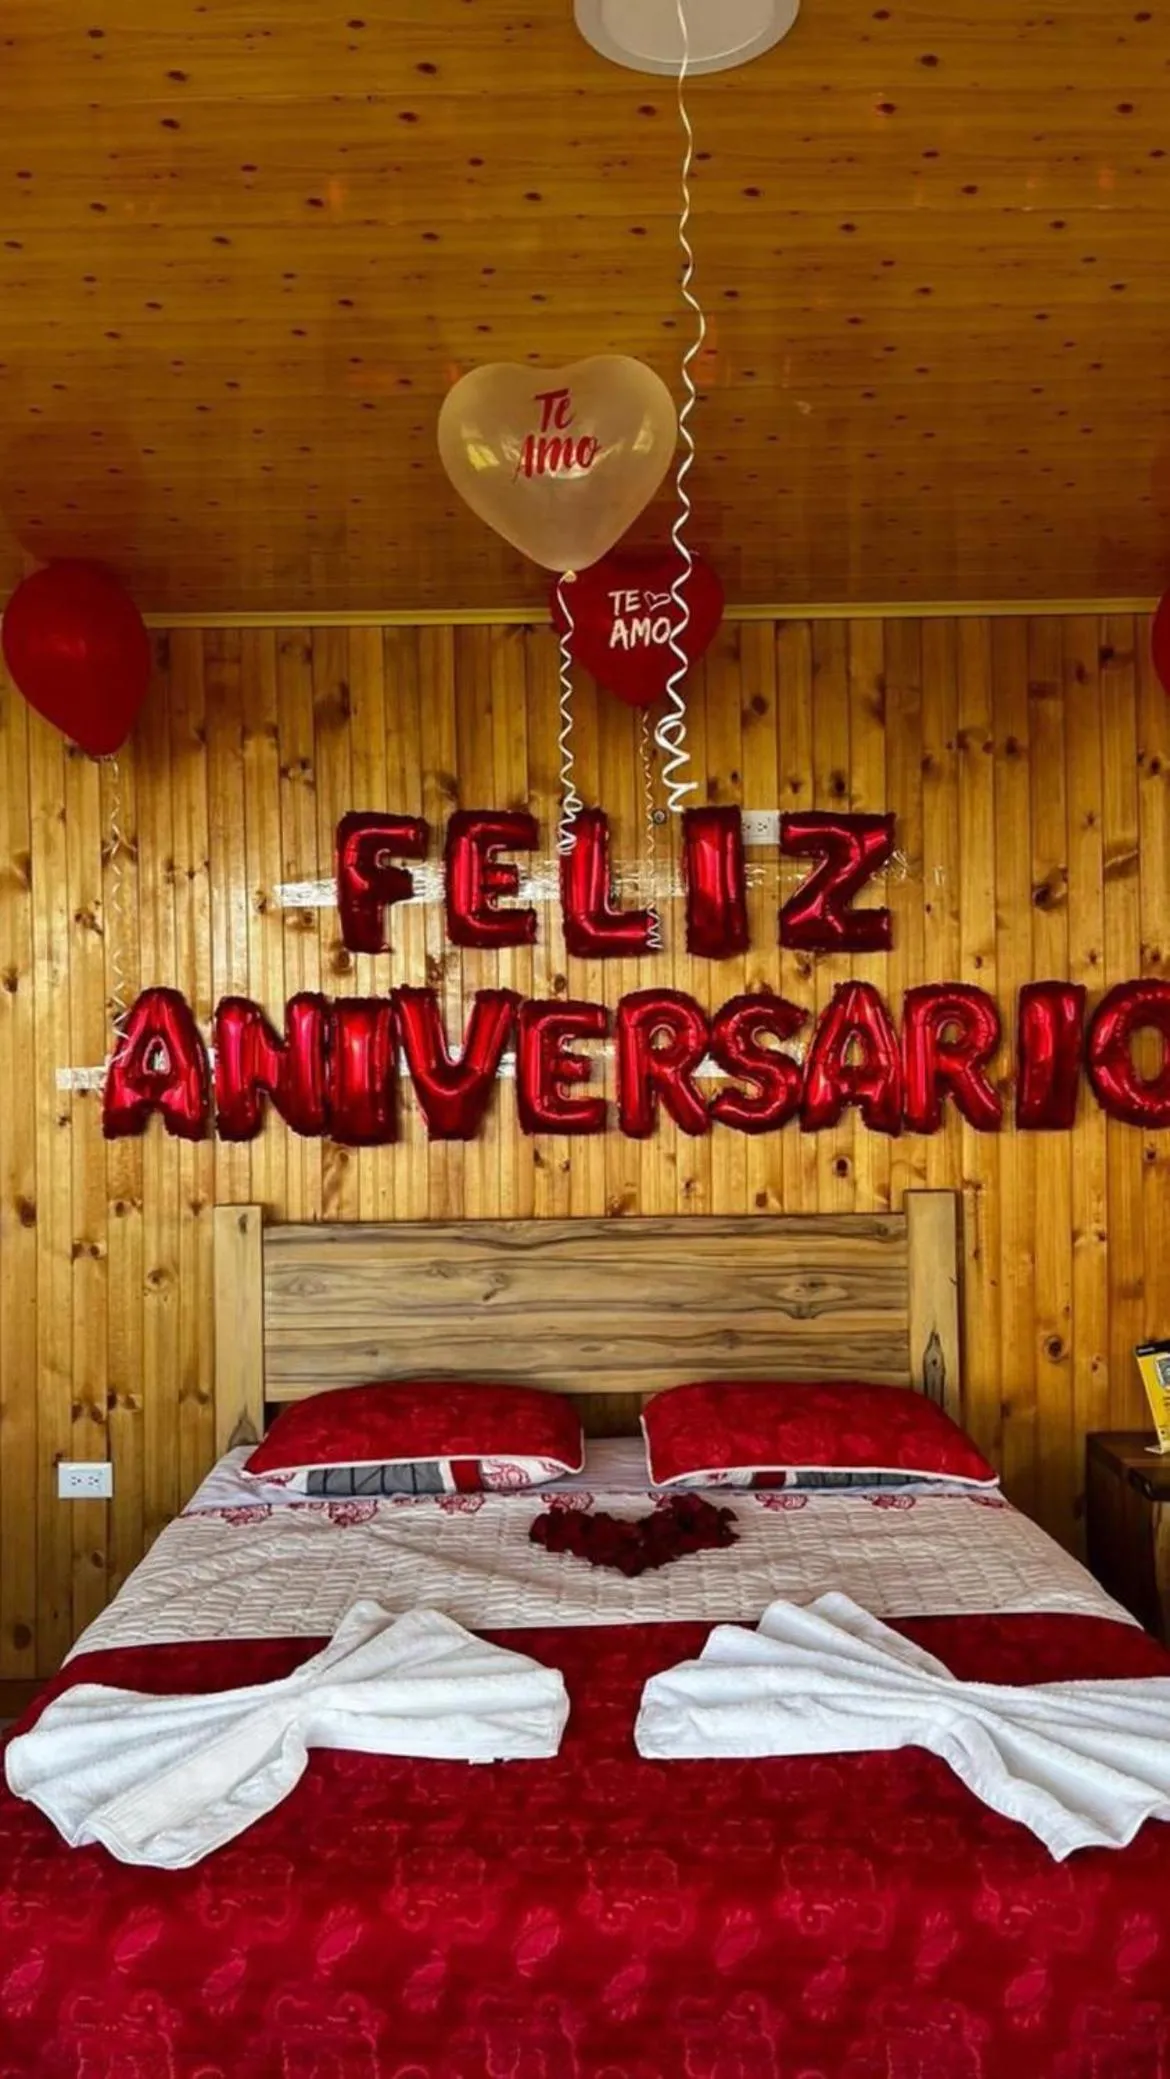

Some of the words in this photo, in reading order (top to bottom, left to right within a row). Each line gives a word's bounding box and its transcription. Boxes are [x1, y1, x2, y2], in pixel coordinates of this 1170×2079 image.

[534, 389, 574, 433] Te
[608, 589, 641, 616] TE
[609, 617, 671, 650] AMO
[336, 807, 895, 959] FELIZ
[103, 980, 1170, 1146] ANIVERSARIO
